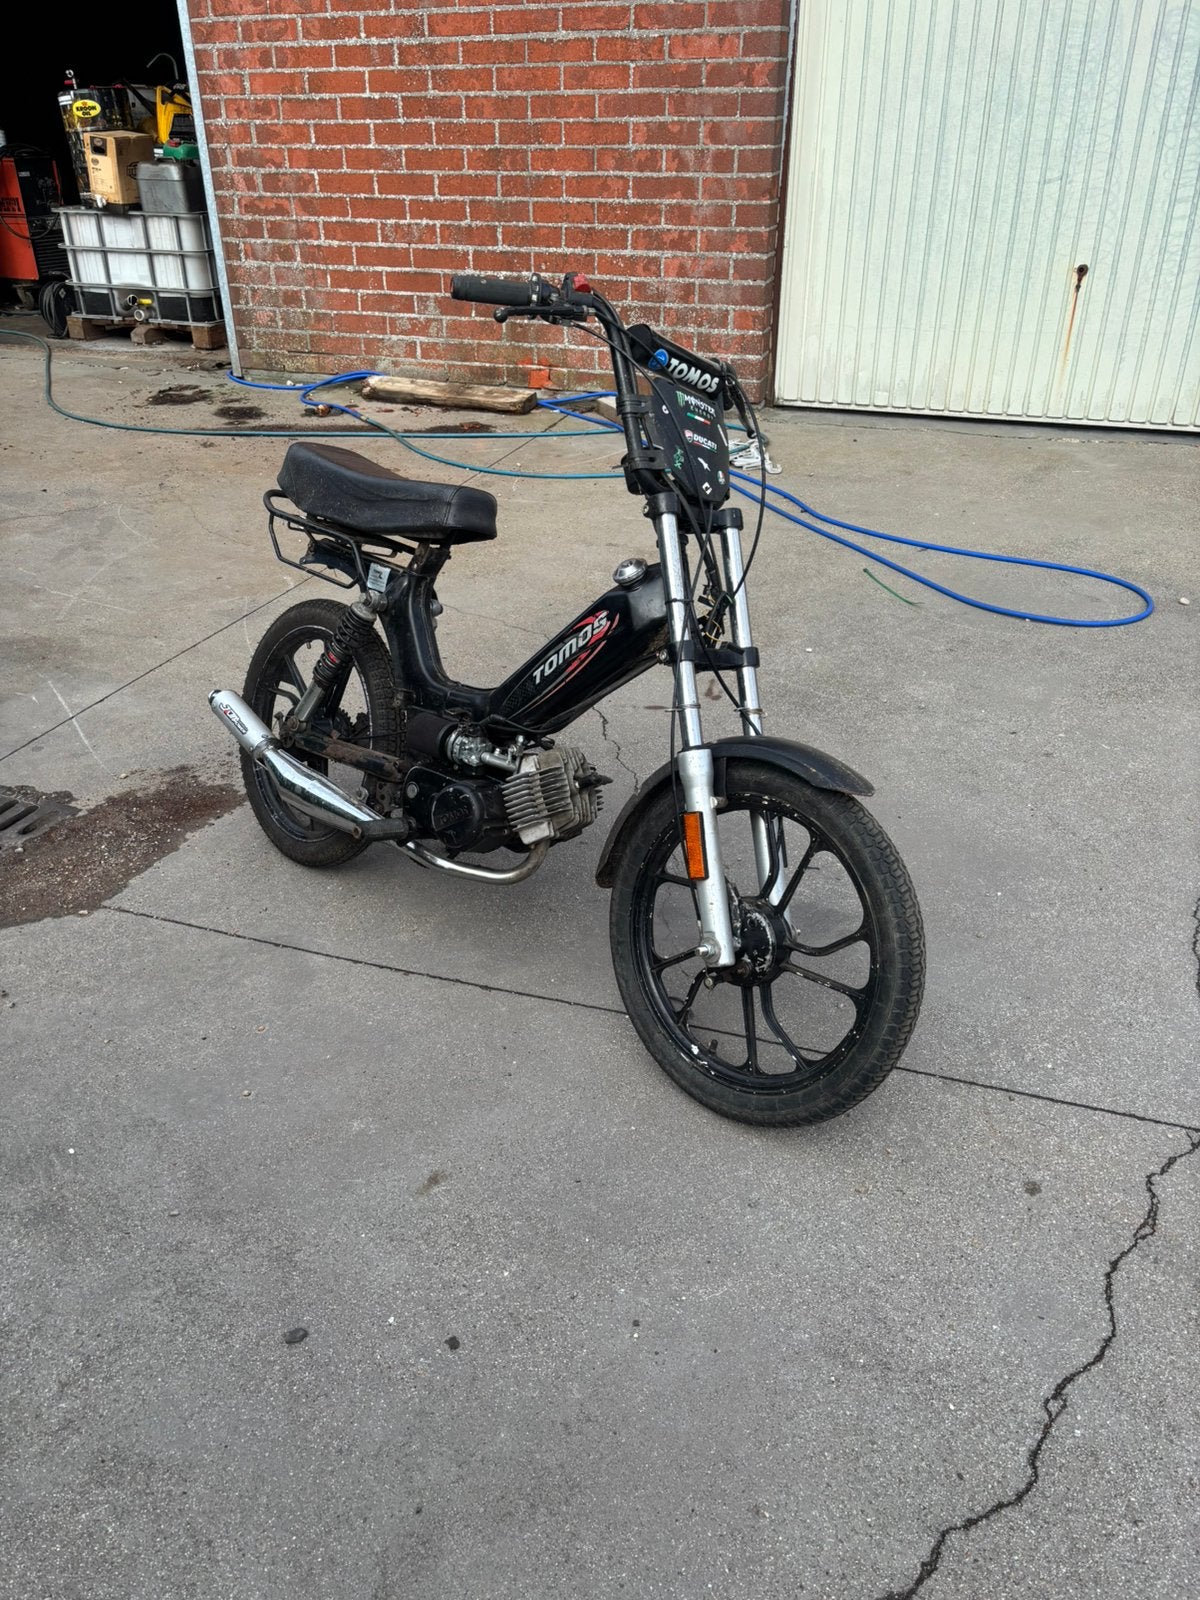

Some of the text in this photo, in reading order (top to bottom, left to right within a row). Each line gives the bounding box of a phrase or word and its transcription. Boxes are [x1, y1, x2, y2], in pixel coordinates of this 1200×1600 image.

[668, 358, 719, 393] TOMOS
[693, 433, 717, 450] DUCATI
[533, 610, 609, 685] TOMOS
